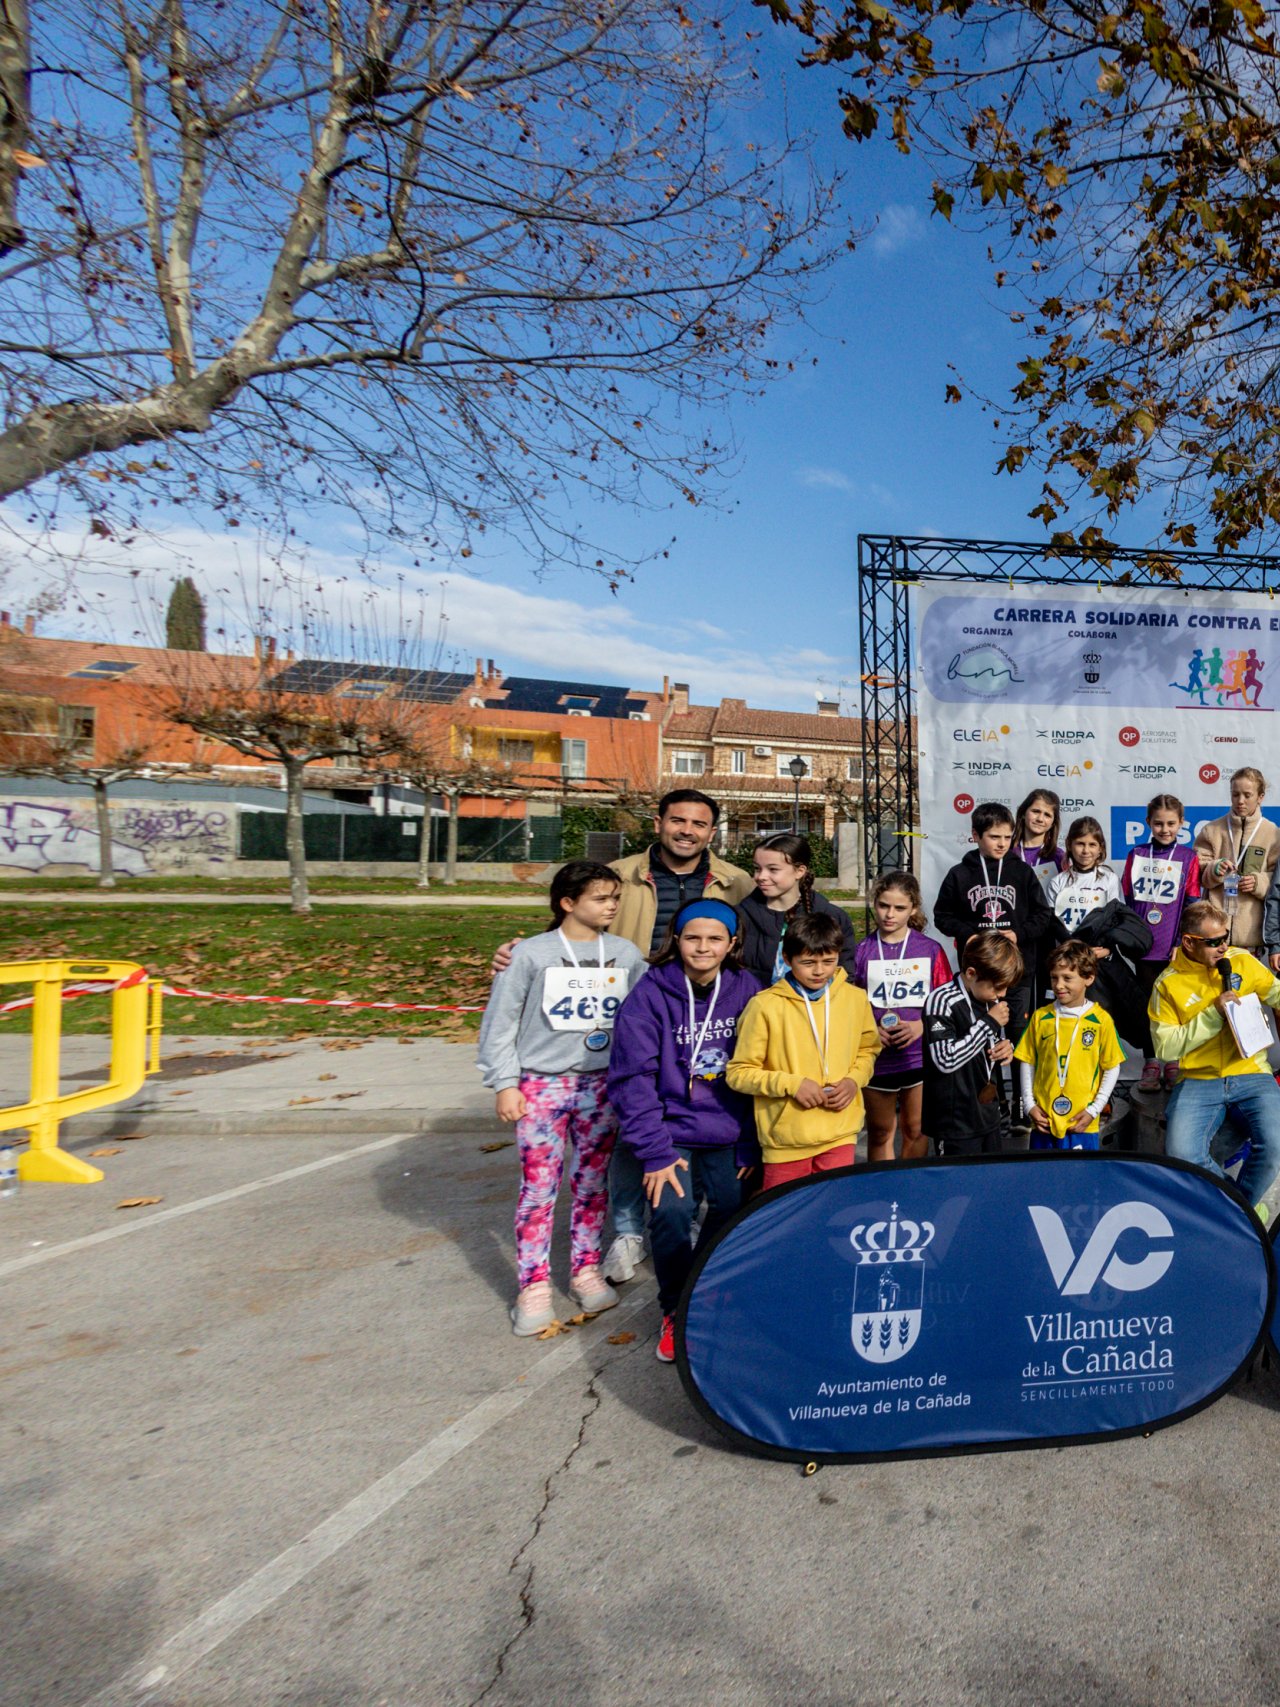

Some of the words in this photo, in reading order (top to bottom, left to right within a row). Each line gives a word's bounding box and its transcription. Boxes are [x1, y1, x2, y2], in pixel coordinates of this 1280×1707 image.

[994, 608, 1076, 623] CARRERA
[1085, 611, 1179, 627] SOLIDARIA
[1188, 615, 1261, 630] CONTRA
[962, 627, 1013, 636] ORGANIZA
[1068, 630, 1117, 639] COLABORA
[953, 729, 999, 742] ELEIA
[1051, 730, 1095, 739] INDRA
[1122, 732, 1136, 742] QP
[968, 762, 1012, 770] INDRA
[1037, 764, 1081, 777] ELEIA
[1133, 765, 1177, 773] INDRA
[1202, 770, 1216, 779] QP
[957, 800, 971, 809] QP
[1134, 877, 1175, 897] 472
[1061, 907, 1087, 924] 47
[873, 980, 926, 1006] 464
[549, 996, 621, 1020] 469
[1028, 1201, 1174, 1296] VC
[1025, 1312, 1174, 1342] Villanueva
[1022, 1363, 1040, 1378] de
[1043, 1361, 1056, 1376] la
[1061, 1341, 1174, 1375] Cañada
[817, 1376, 923, 1396] Ayuntamiento
[928, 1373, 947, 1386] de
[1021, 1383, 1134, 1402] SENCILLAMENTE
[1141, 1379, 1175, 1392] TODO
[788, 1403, 868, 1421] Villanueva
[873, 1400, 892, 1414] de
[897, 1398, 910, 1412] la
[915, 1392, 971, 1410] Cañada
